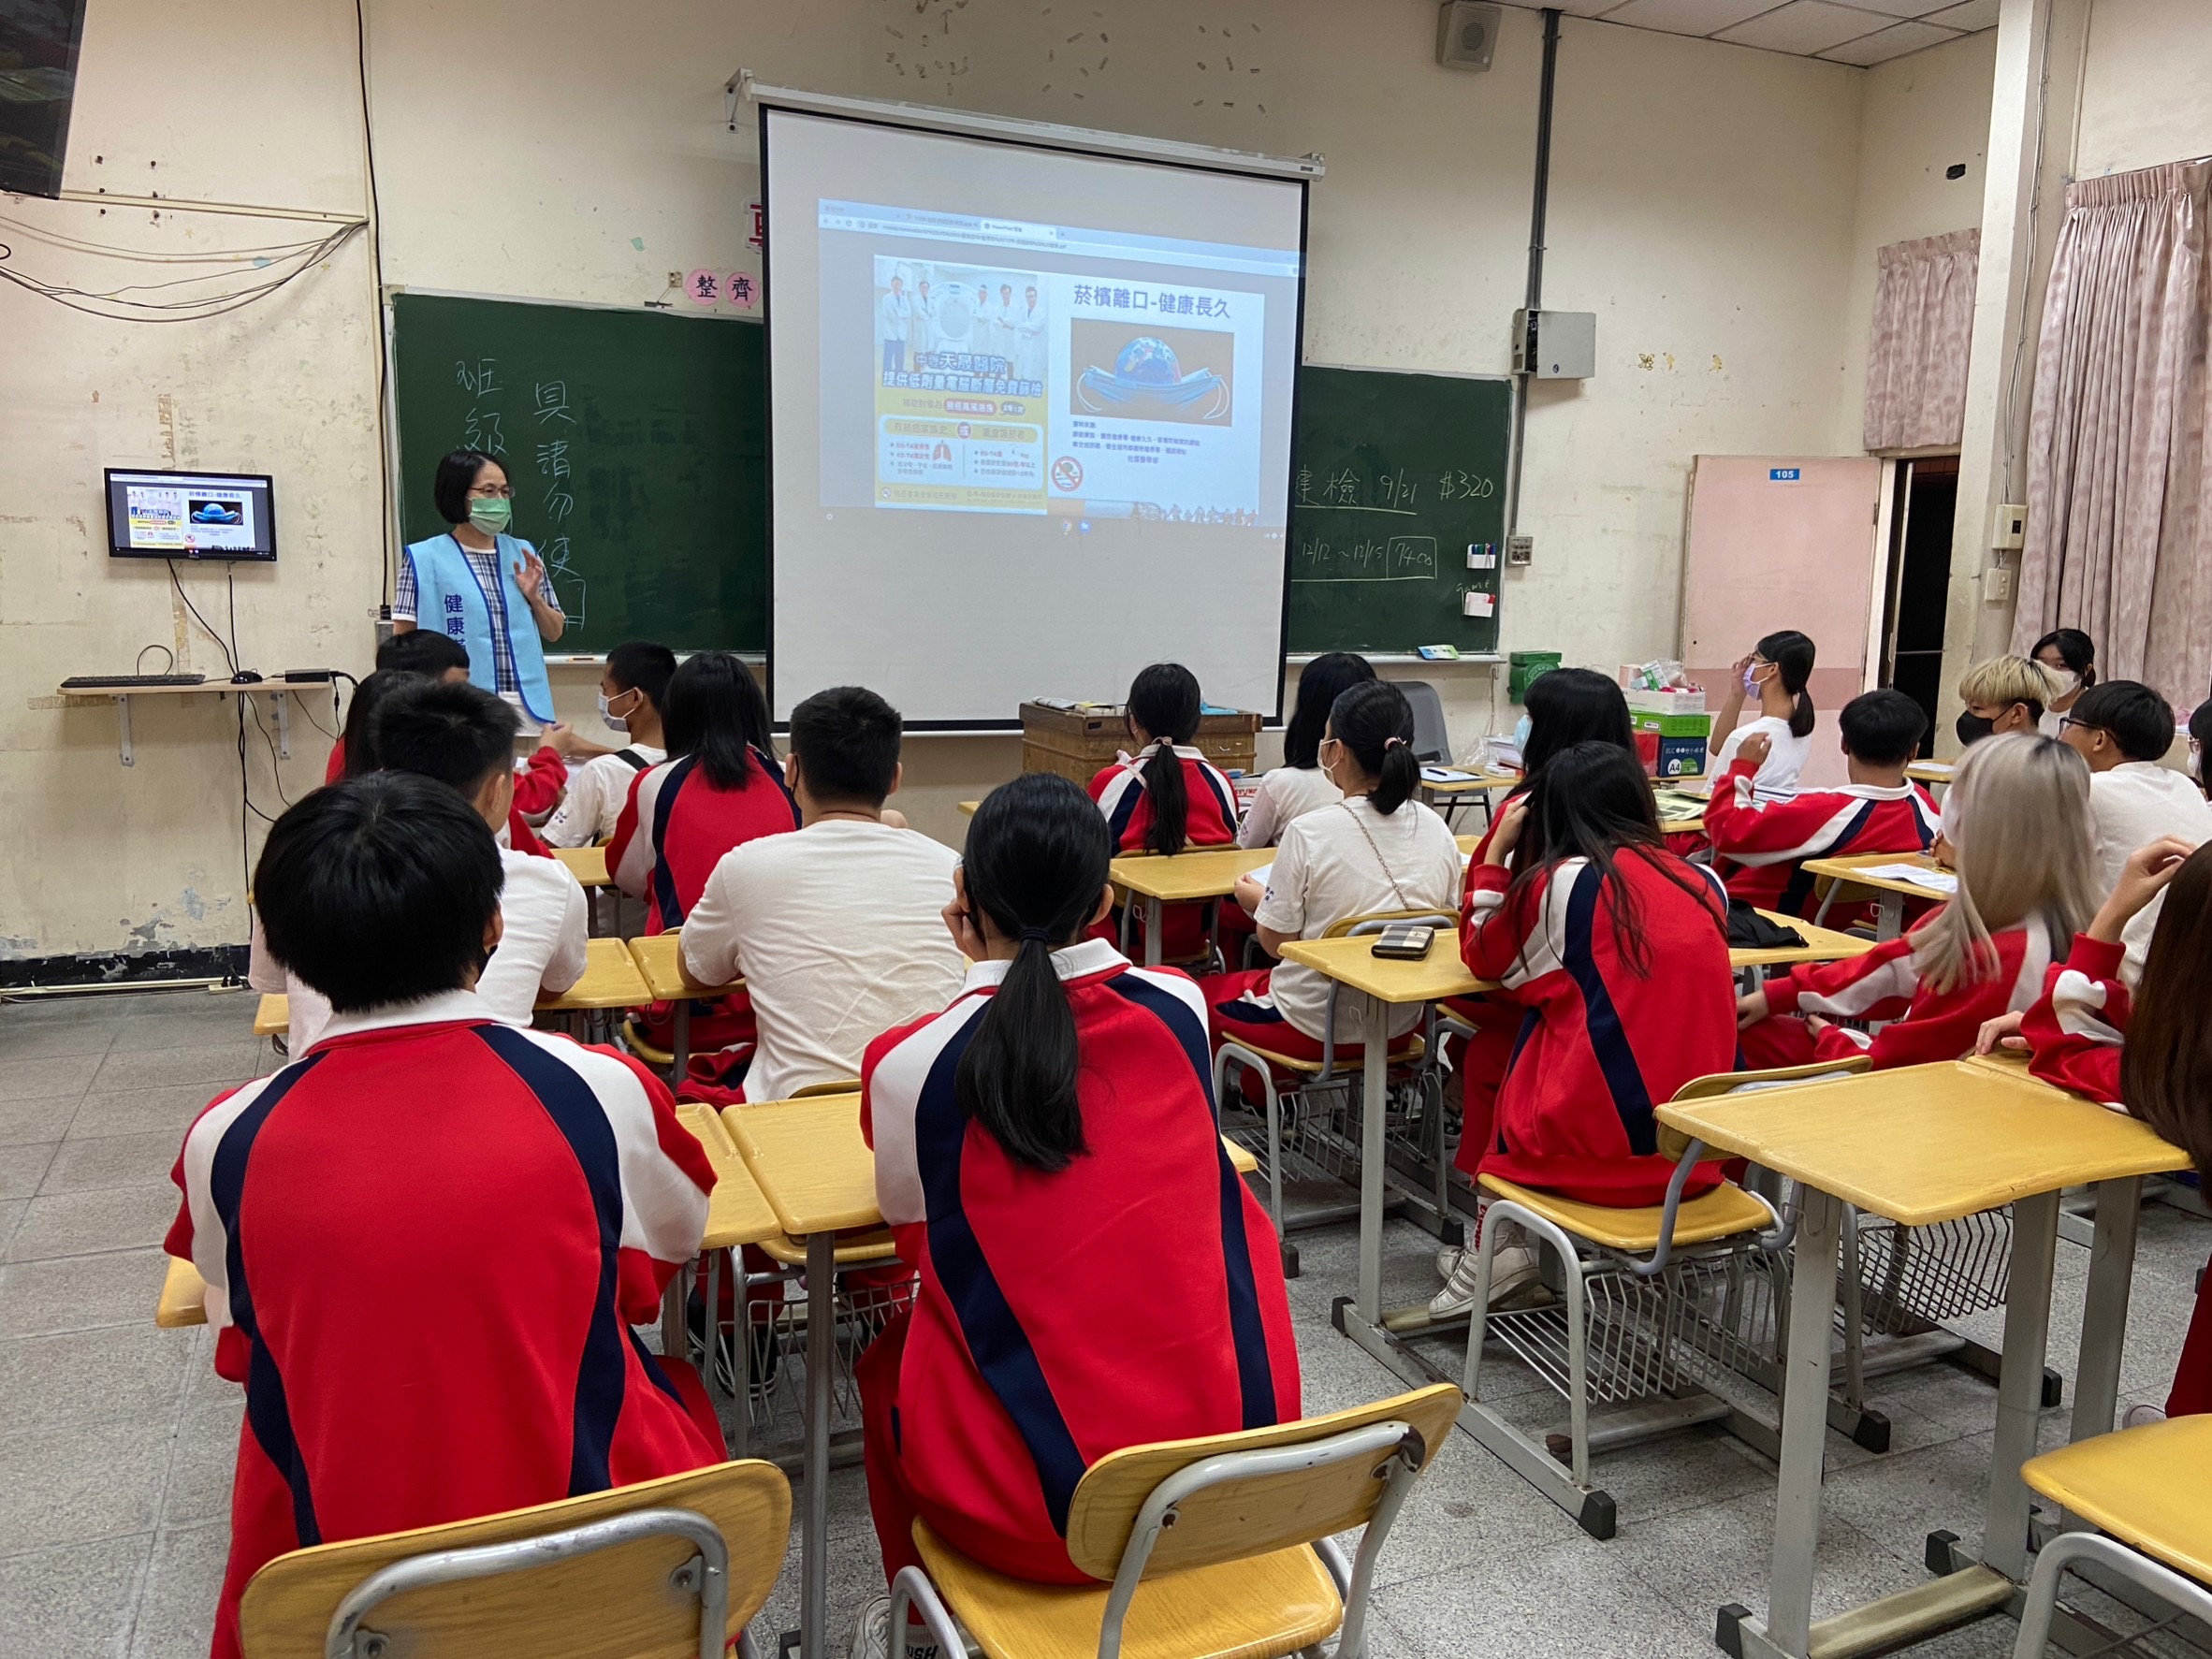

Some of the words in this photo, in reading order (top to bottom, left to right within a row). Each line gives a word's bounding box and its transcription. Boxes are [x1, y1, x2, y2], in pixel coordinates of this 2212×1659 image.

[696, 275, 752, 301] 整齊
[1074, 284, 1230, 319] 菸檳離口-健康長久
[1776, 470, 1795, 479] 105
[1380, 468, 1418, 508] 9/21
[1438, 470, 1494, 501] $320
[1668, 761, 1682, 772] A4
